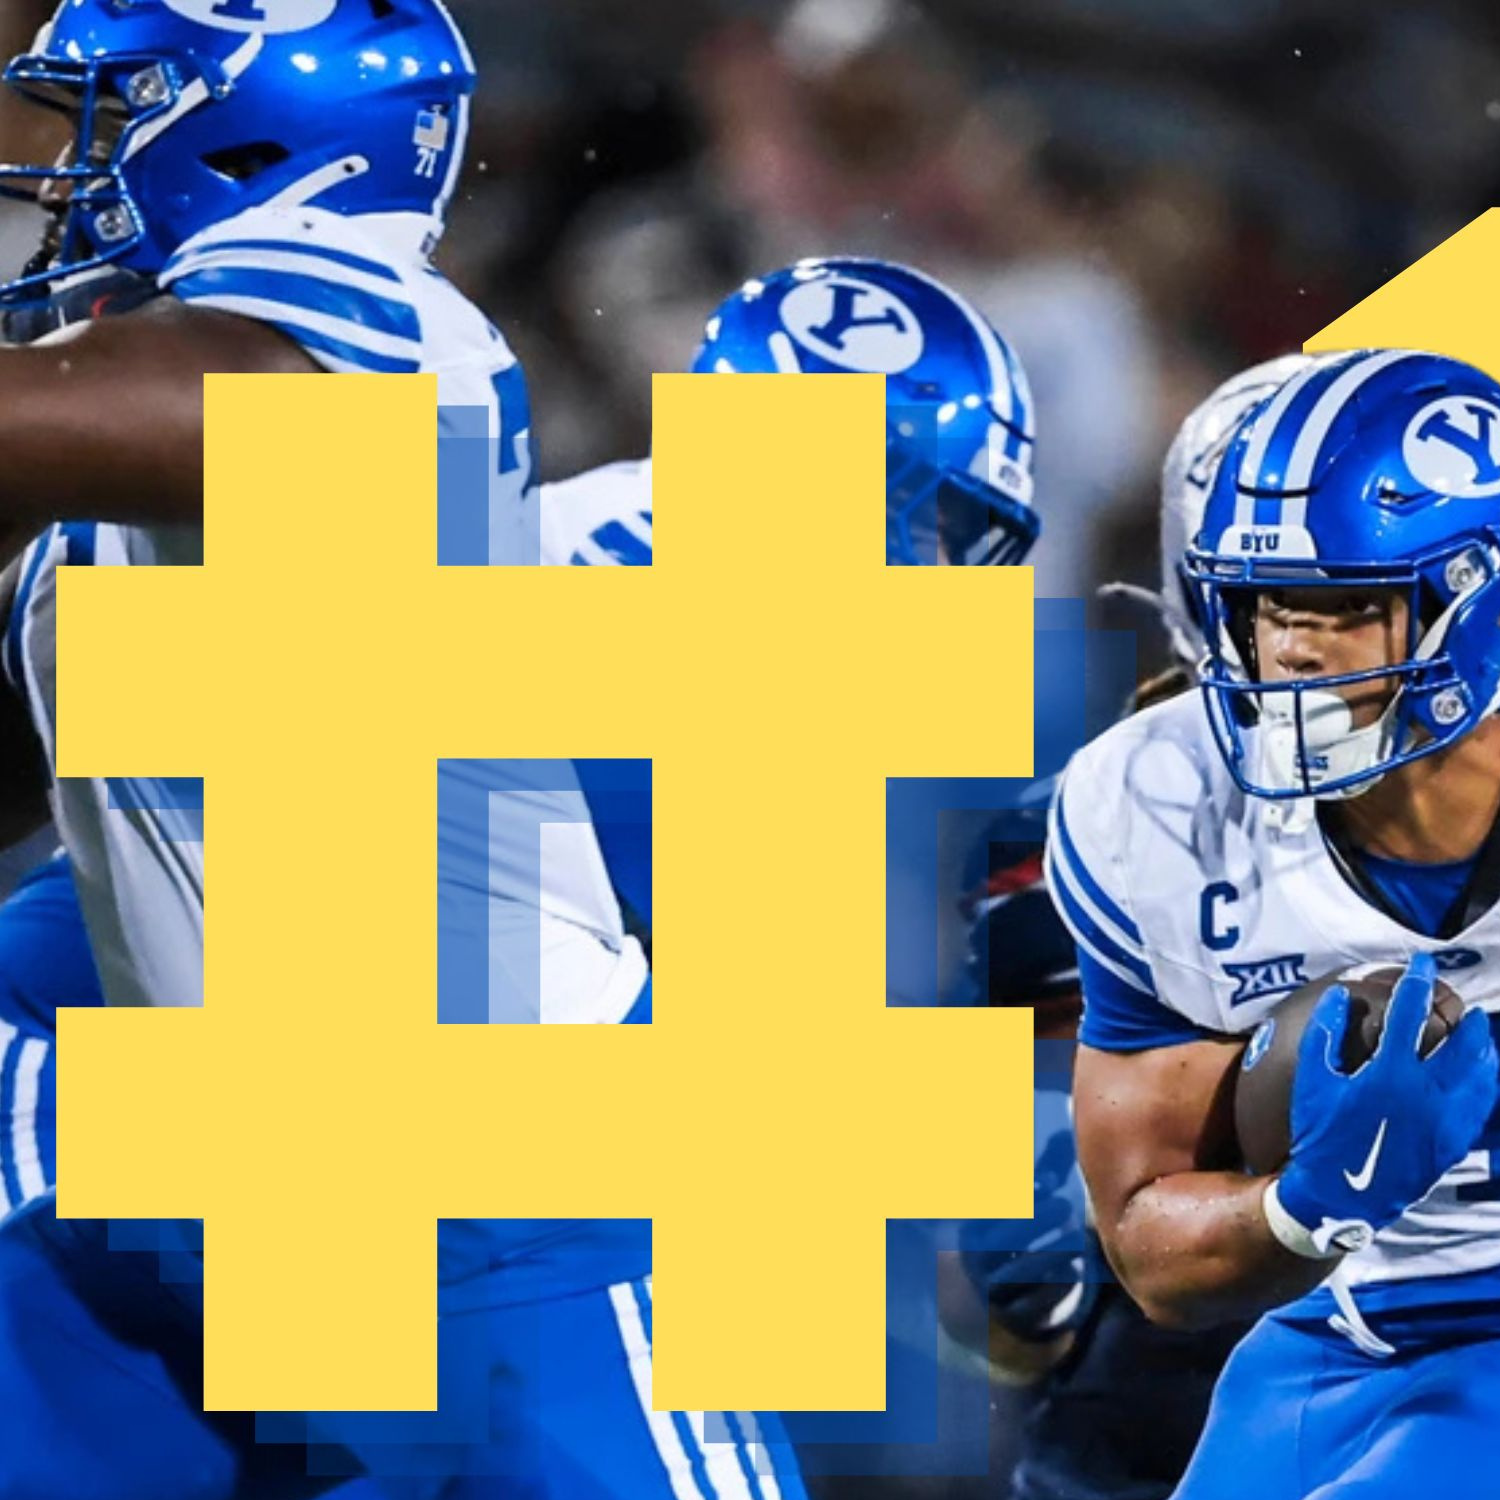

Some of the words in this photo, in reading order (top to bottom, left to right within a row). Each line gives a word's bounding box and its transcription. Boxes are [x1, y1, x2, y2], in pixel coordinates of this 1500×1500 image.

[808, 284, 907, 350] Y
[1240, 533, 1280, 552] BYU
[1200, 881, 1239, 951] C
